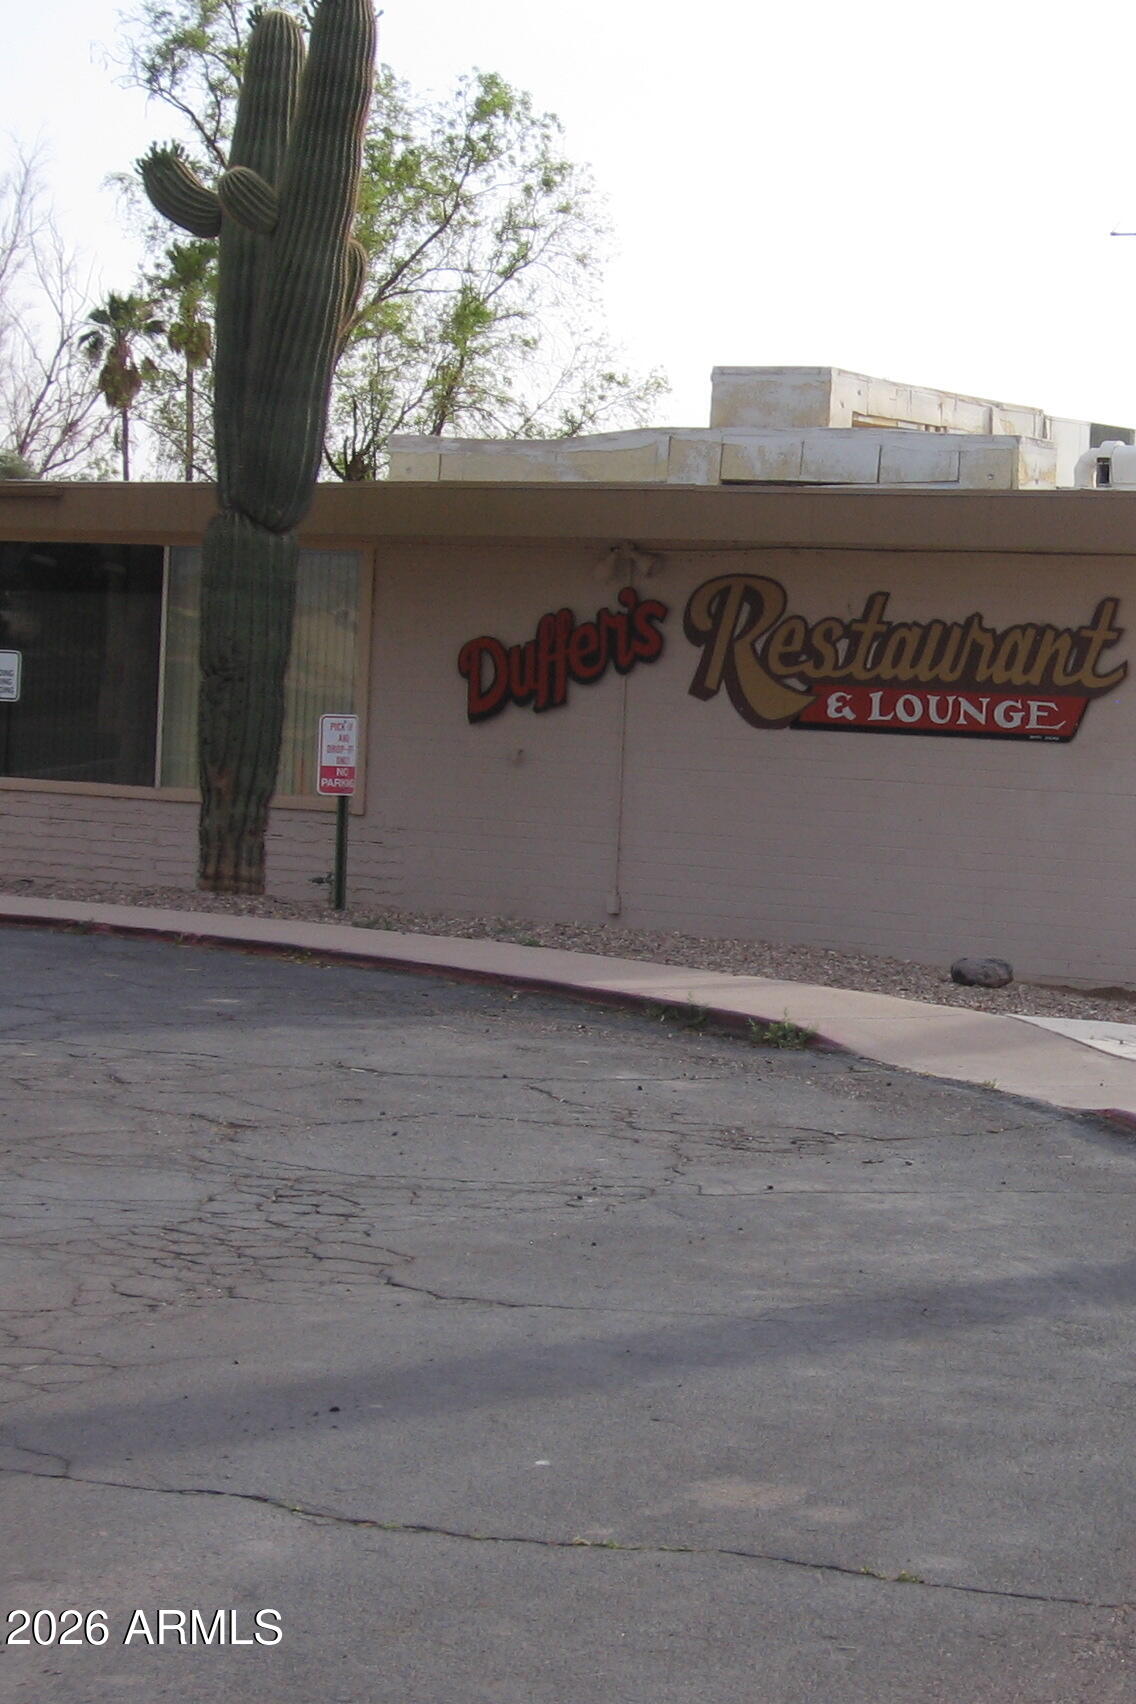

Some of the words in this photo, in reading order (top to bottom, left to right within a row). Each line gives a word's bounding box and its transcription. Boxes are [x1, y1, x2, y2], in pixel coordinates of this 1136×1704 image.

[458, 586, 668, 724] Duffer's
[684, 573, 1128, 729] Restaurant
[826, 692, 856, 720] &
[867, 691, 1067, 730] LOUNGE
